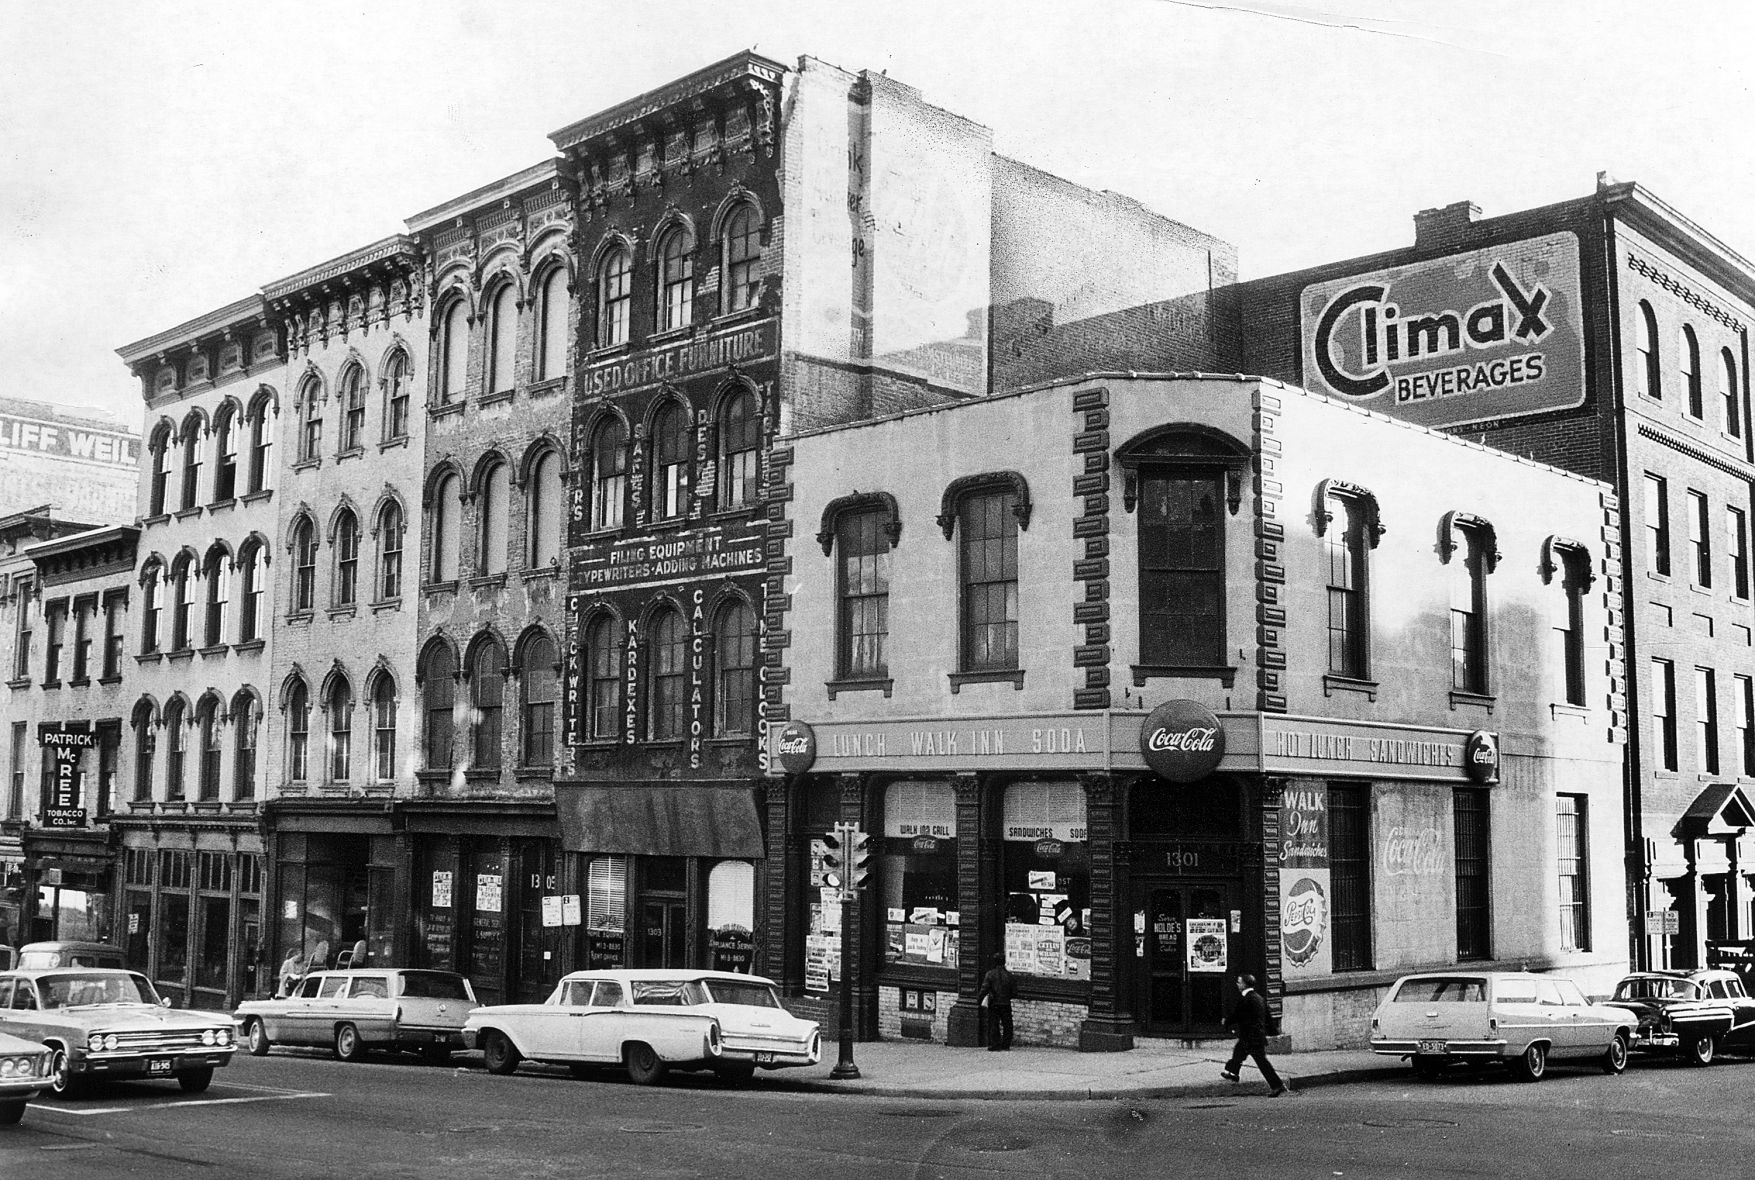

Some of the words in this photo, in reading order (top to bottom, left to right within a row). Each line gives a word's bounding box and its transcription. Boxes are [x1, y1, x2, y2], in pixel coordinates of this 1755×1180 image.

[1314, 260, 1553, 397] Climax
[584, 365, 623, 395] USED
[624, 351, 675, 386] OFFICE
[679, 328, 764, 372] FURNITURE
[1396, 354, 1545, 402] BEVERAGES
[1472, 420, 1500, 431] NEON
[68, 431, 138, 465] WEIL
[610, 547, 646, 565] FILING
[649, 536, 722, 560] EQUIPMENT
[701, 547, 763, 570] MACHINES
[626, 619, 638, 745] KARDEXES
[690, 589, 703, 769] CALCULATORS
[567, 675, 579, 777] WRITERS
[758, 666, 769, 769] CLOCKS
[44, 733, 92, 746] PATRICK
[778, 737, 809, 754] Coca-Cola
[833, 732, 887, 757] LUNCH
[910, 730, 958, 756] WALK
[972, 729, 1005, 755] INN
[1031, 728, 1087, 754] SODA
[1148, 727, 1217, 751] Coca-Cola
[1276, 731, 1300, 757] HOT
[1309, 733, 1352, 760] LUNCH
[1369, 739, 1453, 766] SANDWICHES
[1473, 747, 1497, 765] Coca-Cola
[1283, 791, 1325, 811] WALK
[46, 809, 83, 818] TOBACCO
[1287, 811, 1319, 836] Inn
[900, 825, 918, 835] WALK
[932, 825, 950, 836] GRILL
[1009, 827, 1054, 838] SANDWICHES
[1166, 852, 1199, 867] 1301
[1279, 840, 1328, 861] Sandwiches
[1383, 827, 1444, 876] Coca-Cola
[531, 874, 540, 888] 13
[648, 928, 662, 936] 1303
